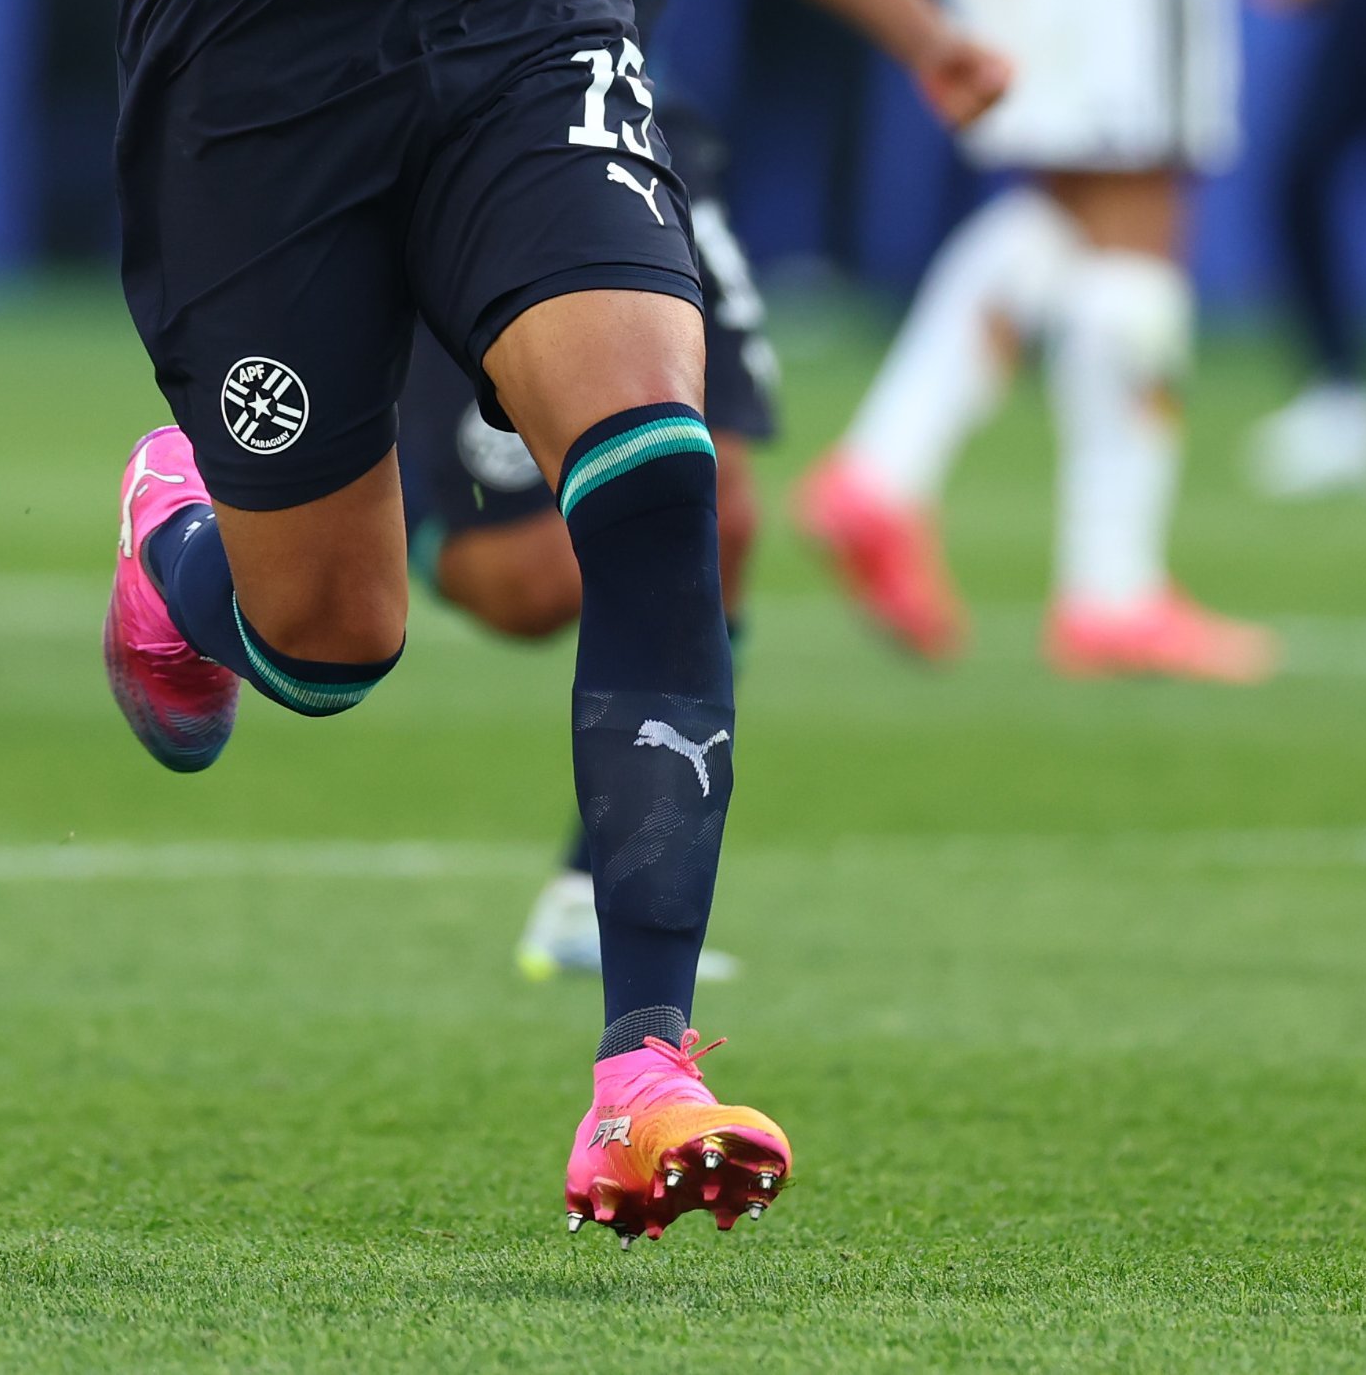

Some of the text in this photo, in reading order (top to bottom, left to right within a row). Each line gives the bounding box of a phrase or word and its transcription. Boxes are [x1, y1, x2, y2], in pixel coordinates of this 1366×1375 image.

[568, 37, 655, 162] 15
[238, 364, 266, 384] APF
[250, 430, 291, 448] PARAGUAY
